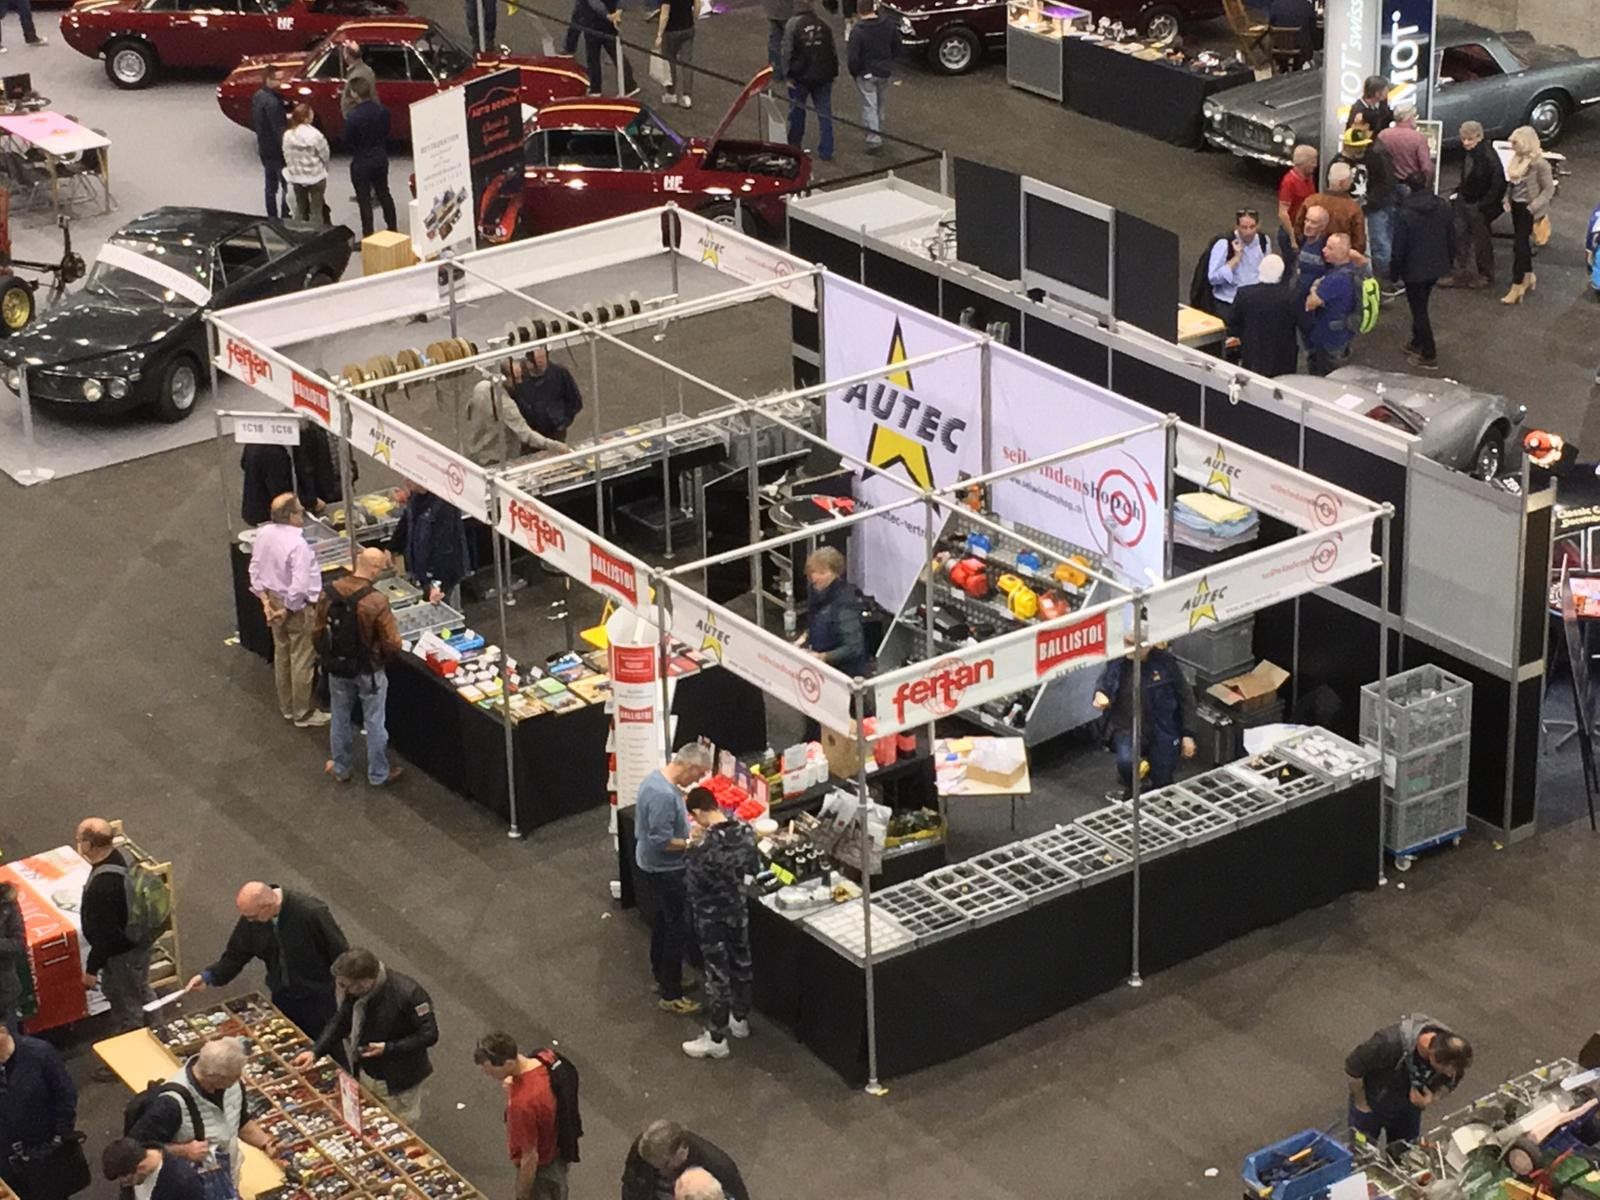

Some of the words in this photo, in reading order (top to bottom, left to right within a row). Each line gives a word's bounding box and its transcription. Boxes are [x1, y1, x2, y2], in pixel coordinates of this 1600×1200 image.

[698, 237, 725, 254] AUTEC
[226, 338, 273, 385] fertan
[841, 382, 968, 454] AUTEC
[1203, 455, 1242, 480] AUTEC
[508, 499, 566, 554] fertan
[1181, 585, 1228, 611] AUTEC
[695, 618, 732, 646] AUTEC
[892, 656, 994, 724] fertan
[1039, 624, 1105, 659] BALLISTOL
